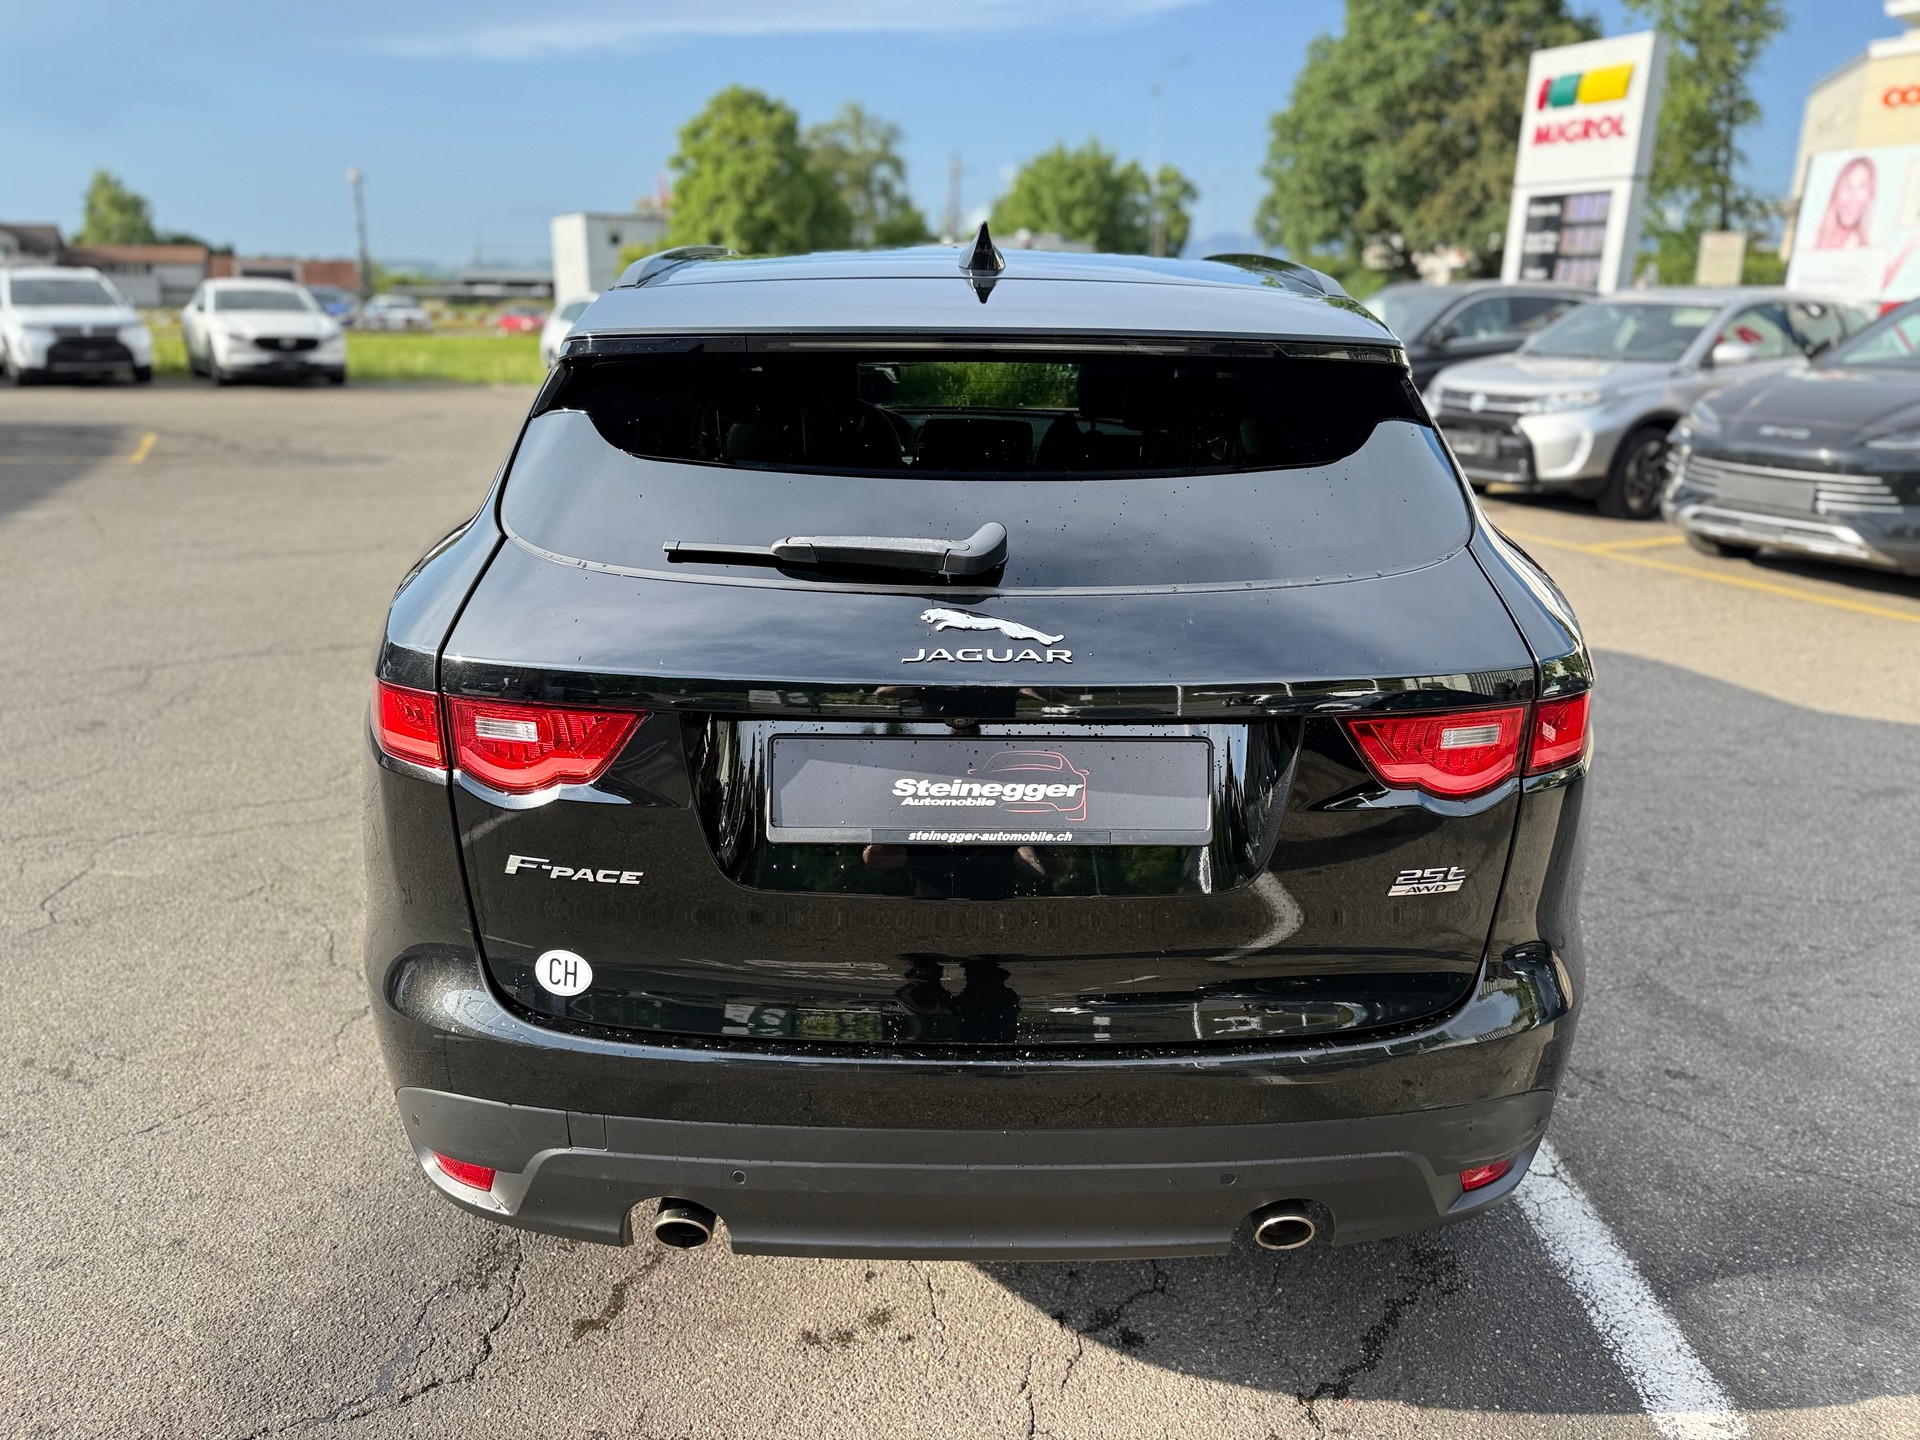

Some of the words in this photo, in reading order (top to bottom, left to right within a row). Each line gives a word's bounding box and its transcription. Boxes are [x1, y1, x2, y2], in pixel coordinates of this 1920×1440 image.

[1532, 113, 1625, 146] MIGROL
[902, 648, 1073, 664] JAGUAR
[892, 778, 1084, 801] Steinegger
[900, 796, 997, 807] Automobile
[908, 830, 1073, 844] steinegger-automobile.ch
[504, 854, 644, 885] F-PACE
[1395, 866, 1466, 884] 25t
[1405, 884, 1447, 894] AWD
[549, 957, 578, 988] CH
